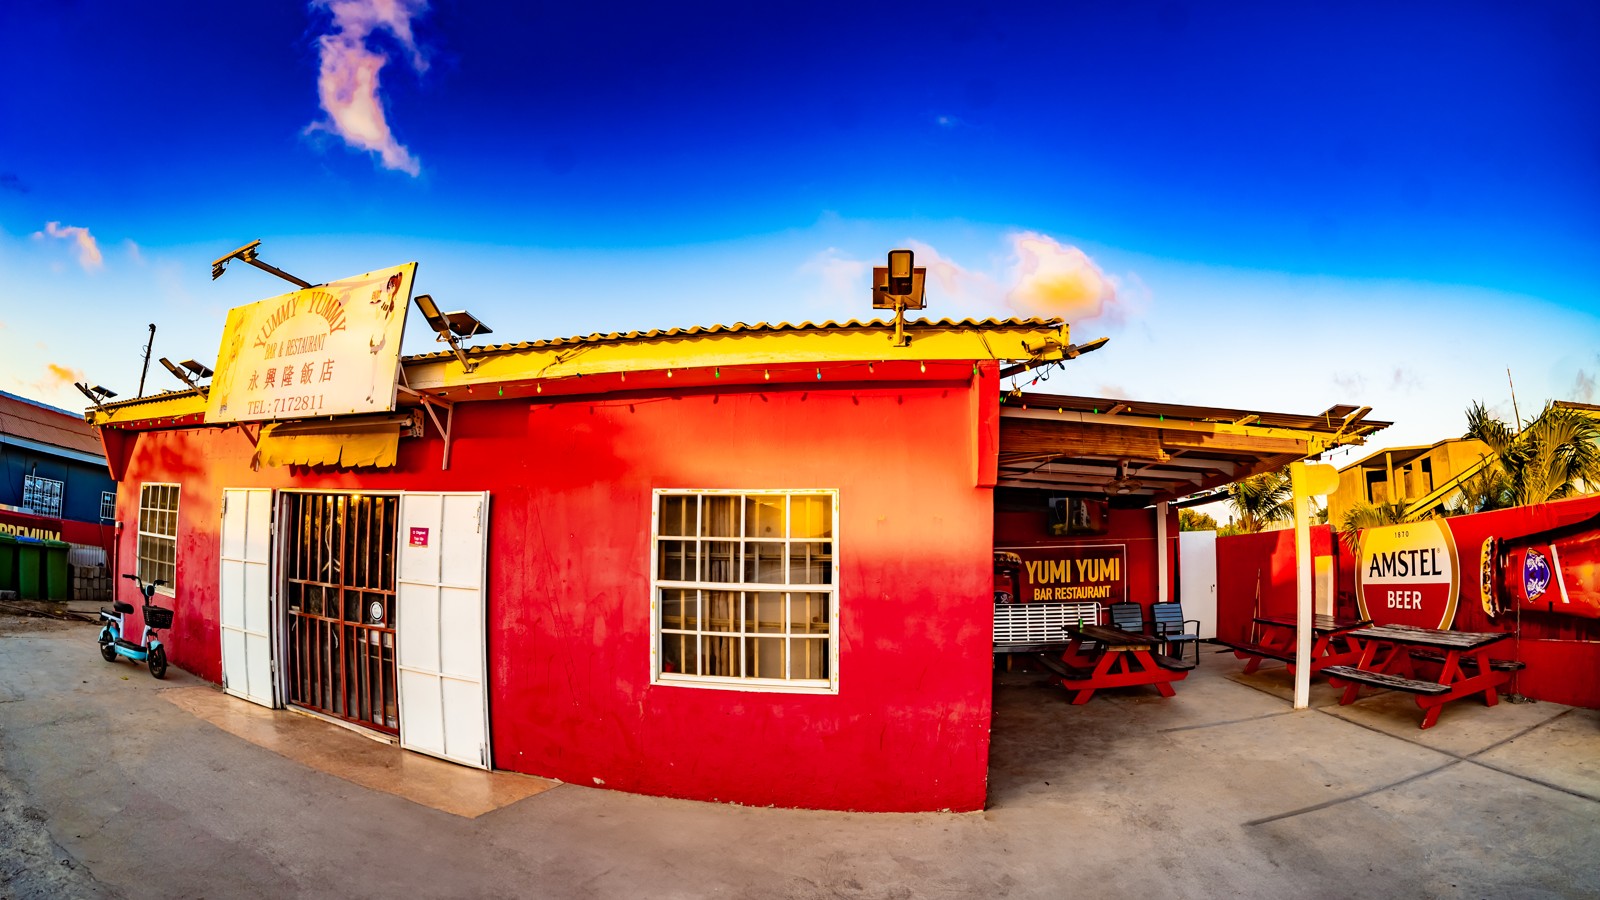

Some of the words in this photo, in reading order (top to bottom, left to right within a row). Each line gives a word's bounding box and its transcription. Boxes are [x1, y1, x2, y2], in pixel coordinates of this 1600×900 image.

[253, 295, 301, 348] YUMMY
[307, 291, 346, 335] YUMMY
[264, 342, 277, 360] BAR
[278, 341, 284, 357] &
[285, 333, 327, 356] RESTAURANT
[247, 358, 335, 391] 永興隆飯店
[1394, 530, 1409, 538] 1870
[1025, 560, 1071, 584] YUMI
[1075, 557, 1120, 582] YUMI
[1369, 548, 1442, 577] AMSTEL
[1034, 587, 1052, 600] BAR
[1055, 585, 1111, 600] RESTAURANT
[1387, 590, 1422, 610] BEER
